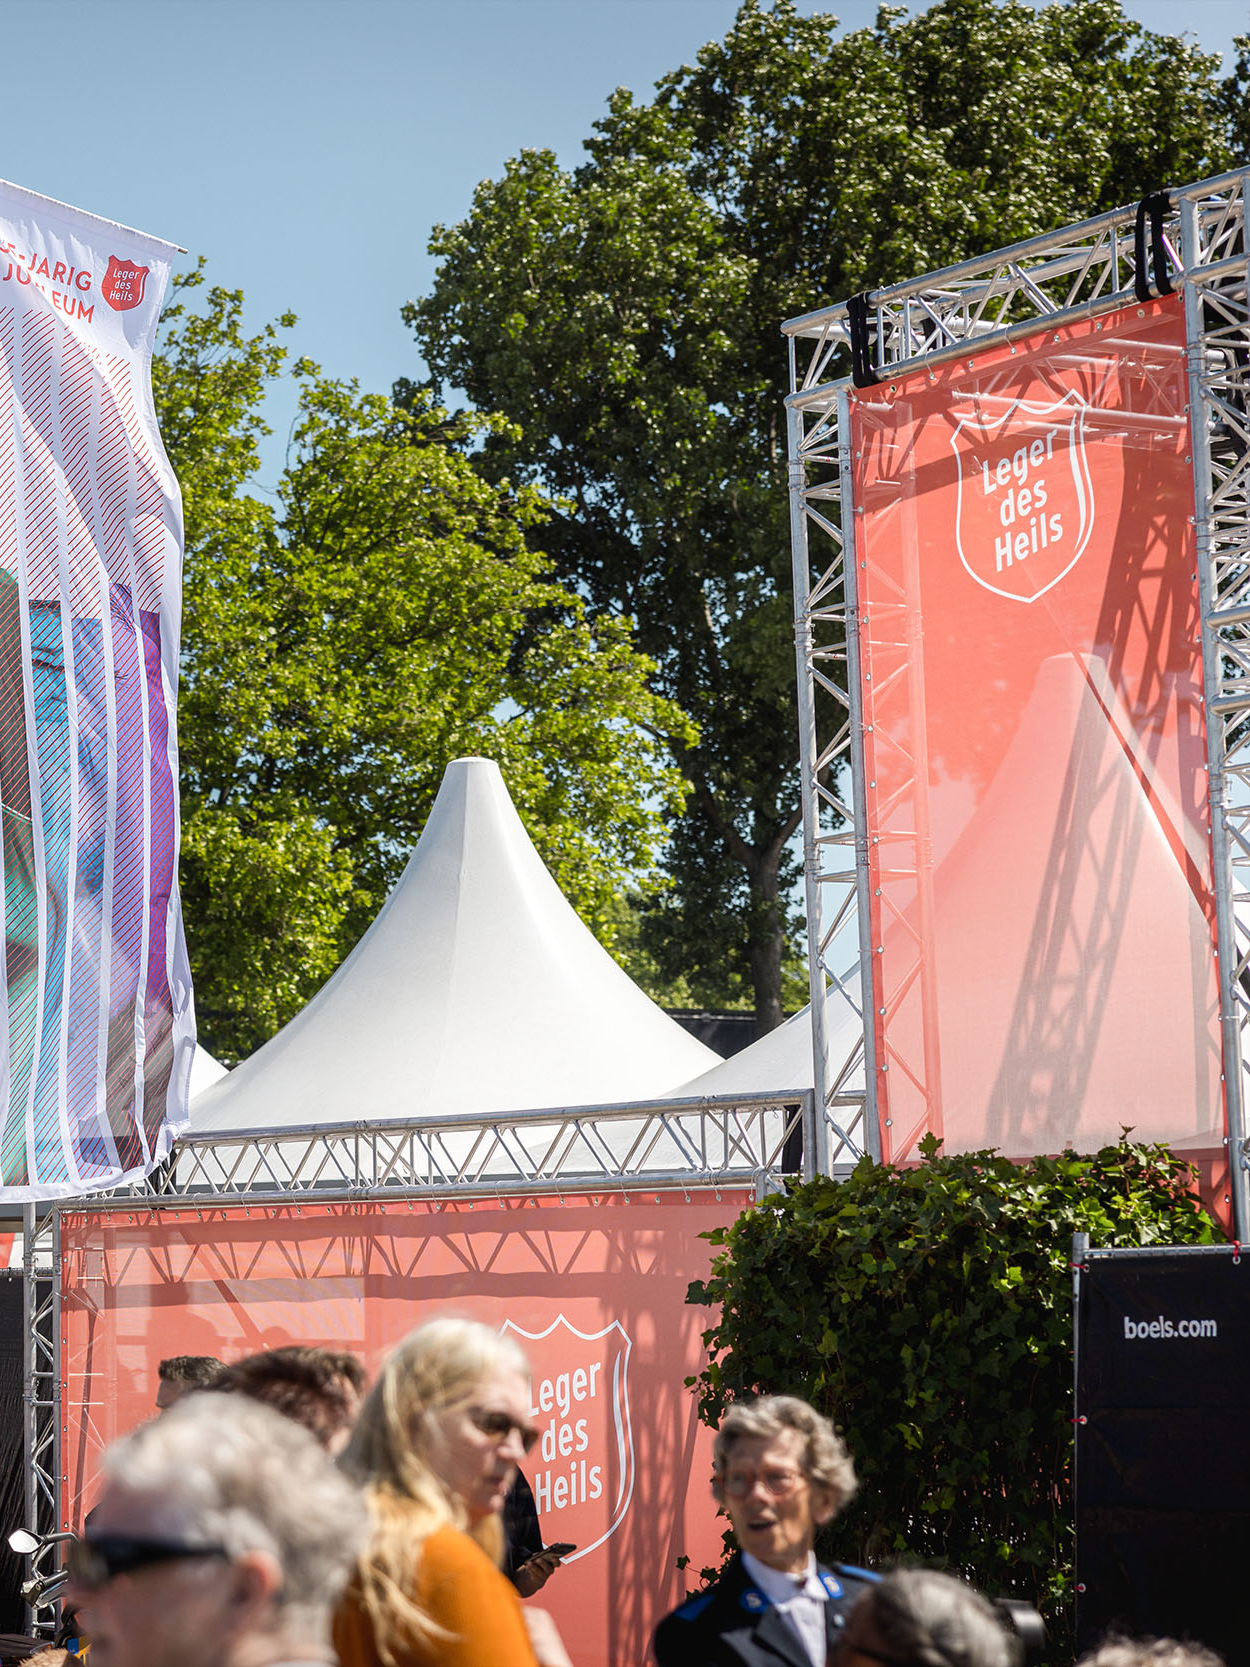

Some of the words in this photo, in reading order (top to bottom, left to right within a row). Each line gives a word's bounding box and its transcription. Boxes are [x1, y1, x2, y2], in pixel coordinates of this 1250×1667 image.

[110, 290, 133, 302] Heils
[113, 268, 139, 280] Leger
[114, 279, 131, 290] des
[982, 429, 1058, 495] Leger
[999, 479, 1048, 527] des
[994, 512, 1064, 573] Heils
[1124, 1315, 1218, 1339] boels.com
[527, 1362, 602, 1418] Leger
[541, 1419, 589, 1463] des
[535, 1459, 603, 1516] Heils
